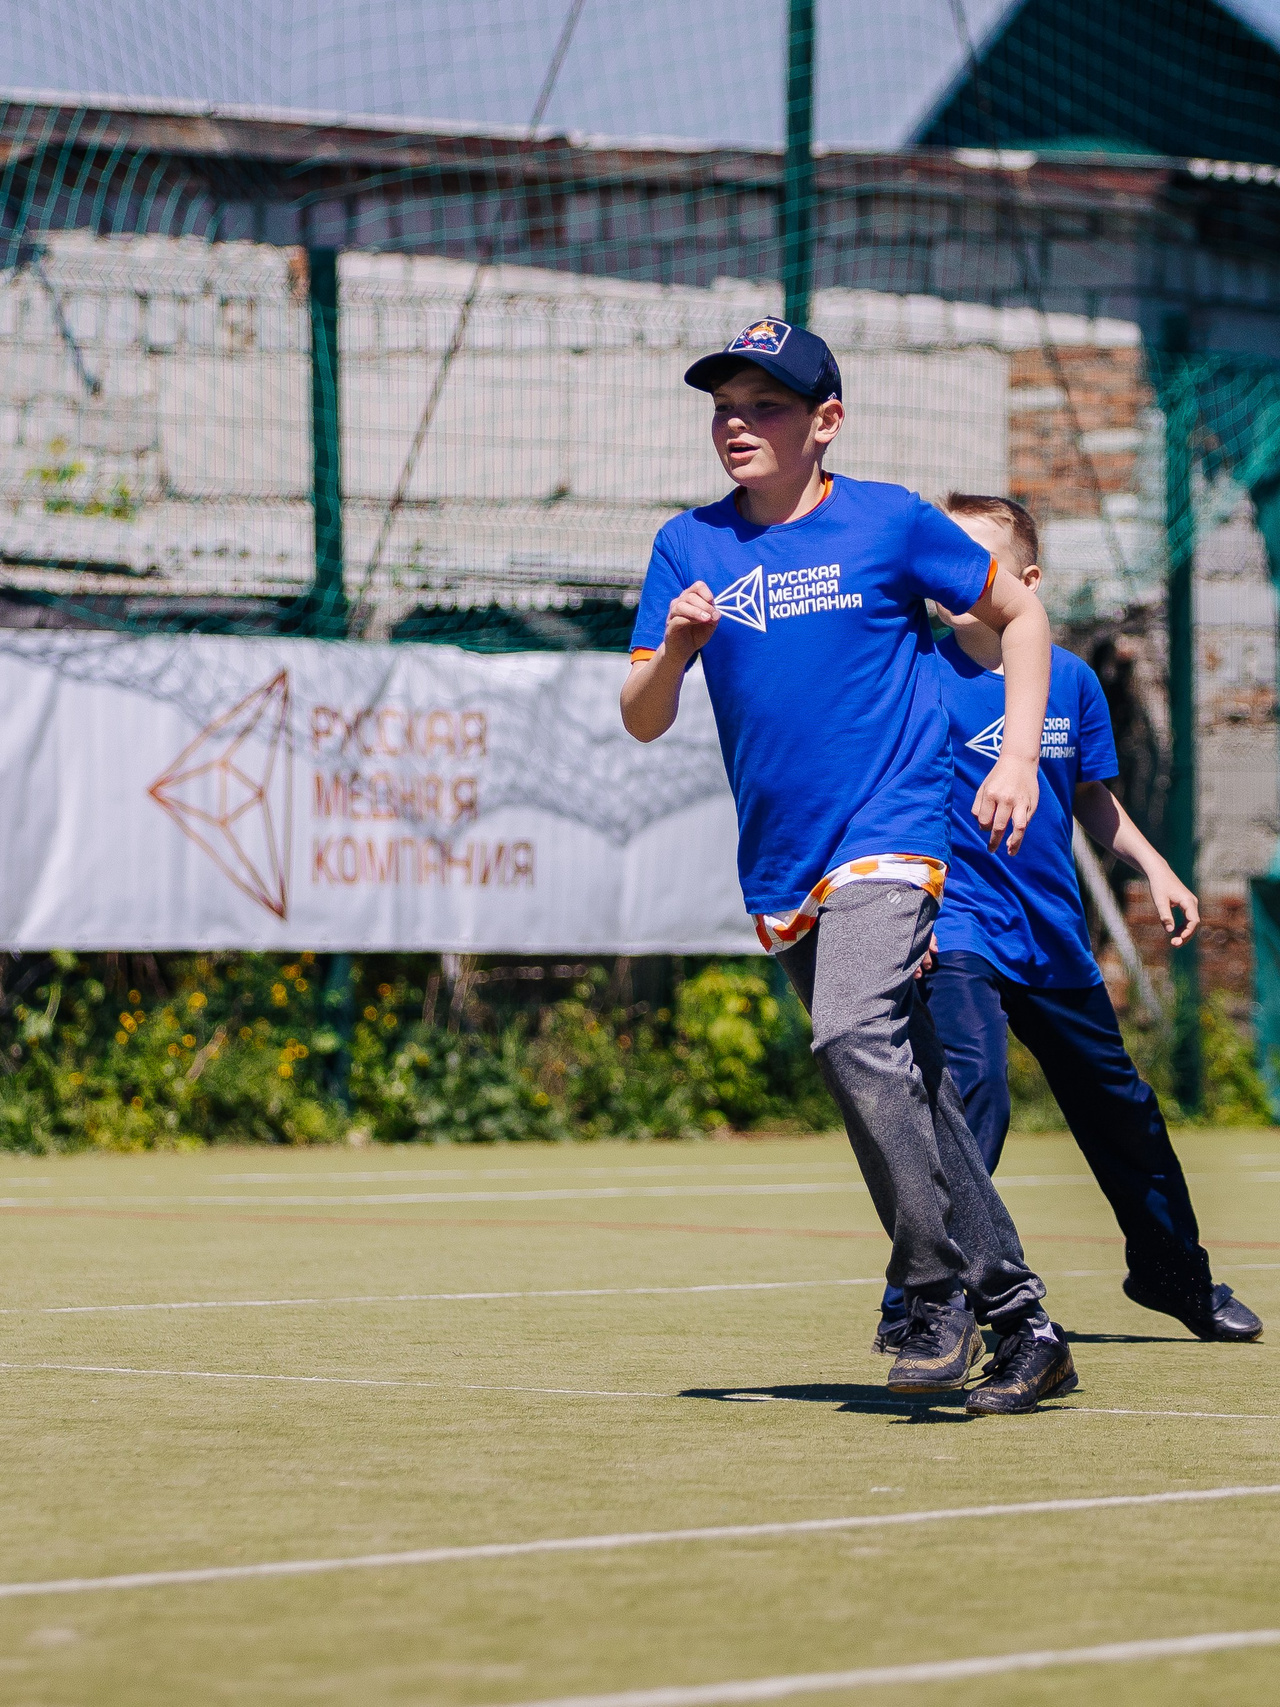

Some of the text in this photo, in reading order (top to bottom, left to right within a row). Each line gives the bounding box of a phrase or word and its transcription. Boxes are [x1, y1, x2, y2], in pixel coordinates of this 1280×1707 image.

[767, 564, 841, 588] РУССКАЯ
[768, 579, 839, 604] МЕДНАЯ
[769, 593, 863, 619] КОМПАНИЯ
[1043, 717, 1070, 731] СКАЯ
[1040, 732, 1068, 745] ДНАЯ
[312, 770, 478, 821] МЕДНАЯ
[312, 835, 536, 886] КОМПАНИЯ
